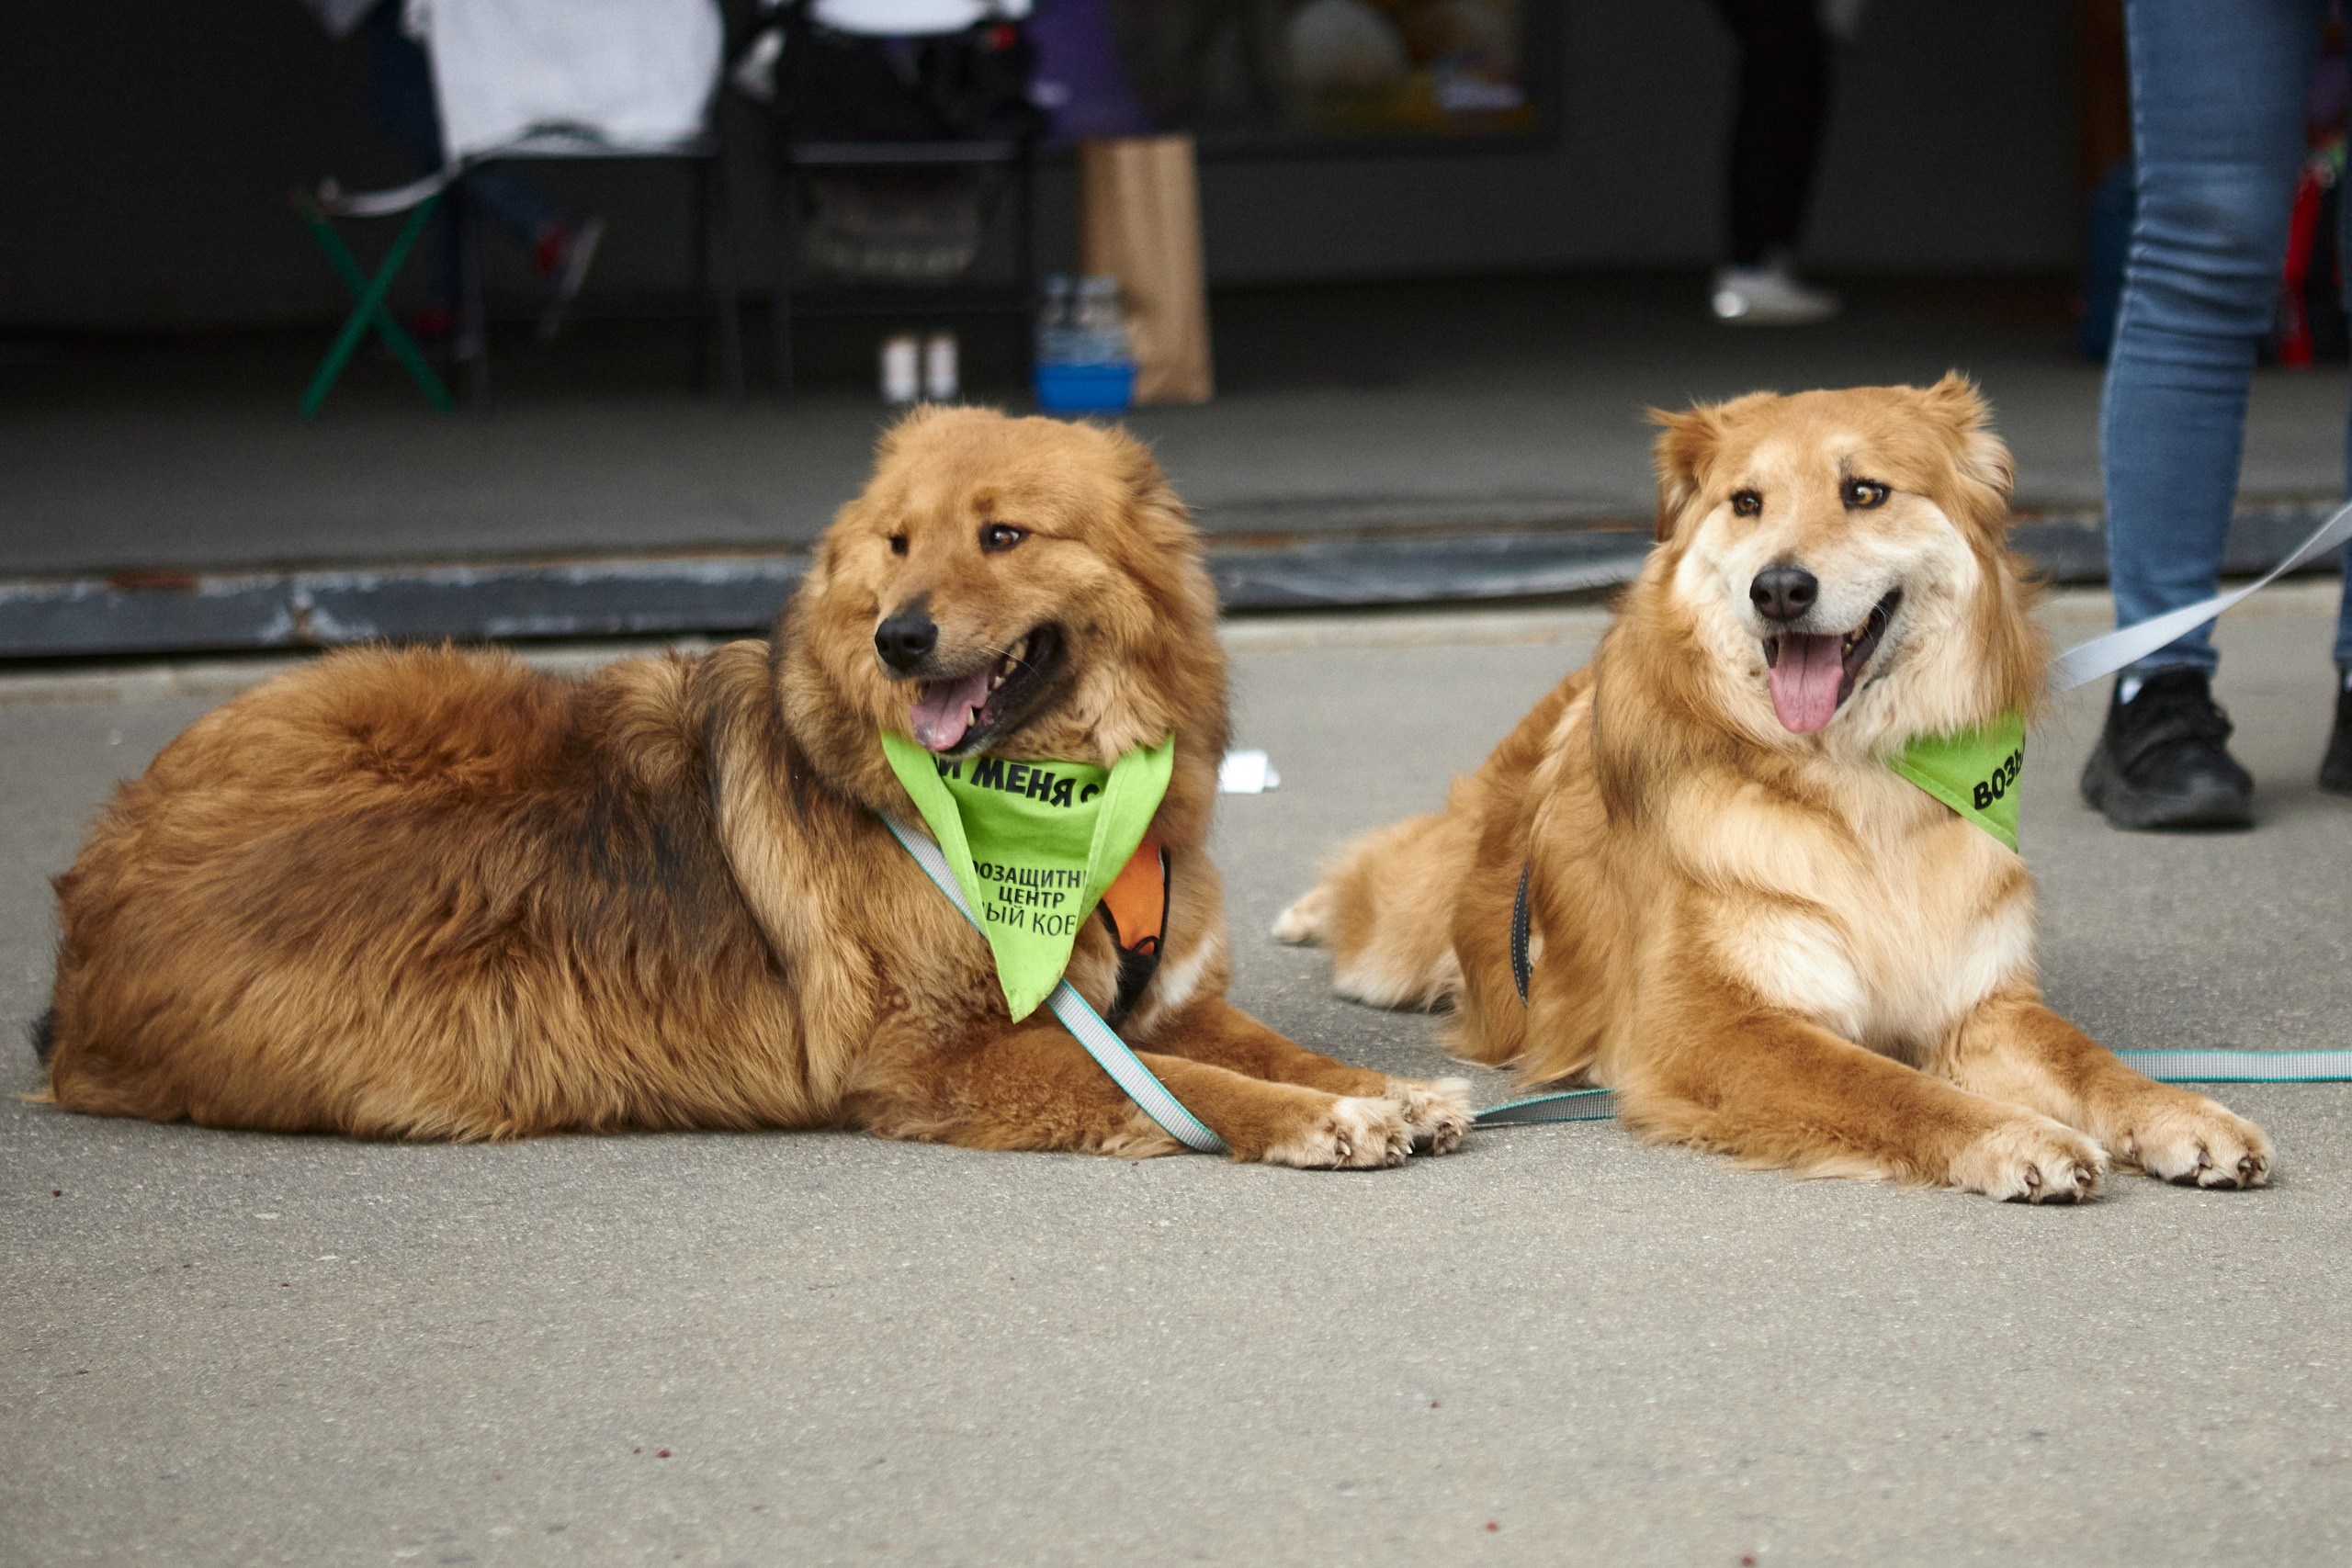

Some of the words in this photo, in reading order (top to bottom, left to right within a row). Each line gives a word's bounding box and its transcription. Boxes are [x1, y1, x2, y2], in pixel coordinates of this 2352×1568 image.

[969, 758, 1077, 807] МЕНЯ
[999, 886, 1066, 908] ЦЕНТР
[982, 901, 1025, 929] ЫЙ
